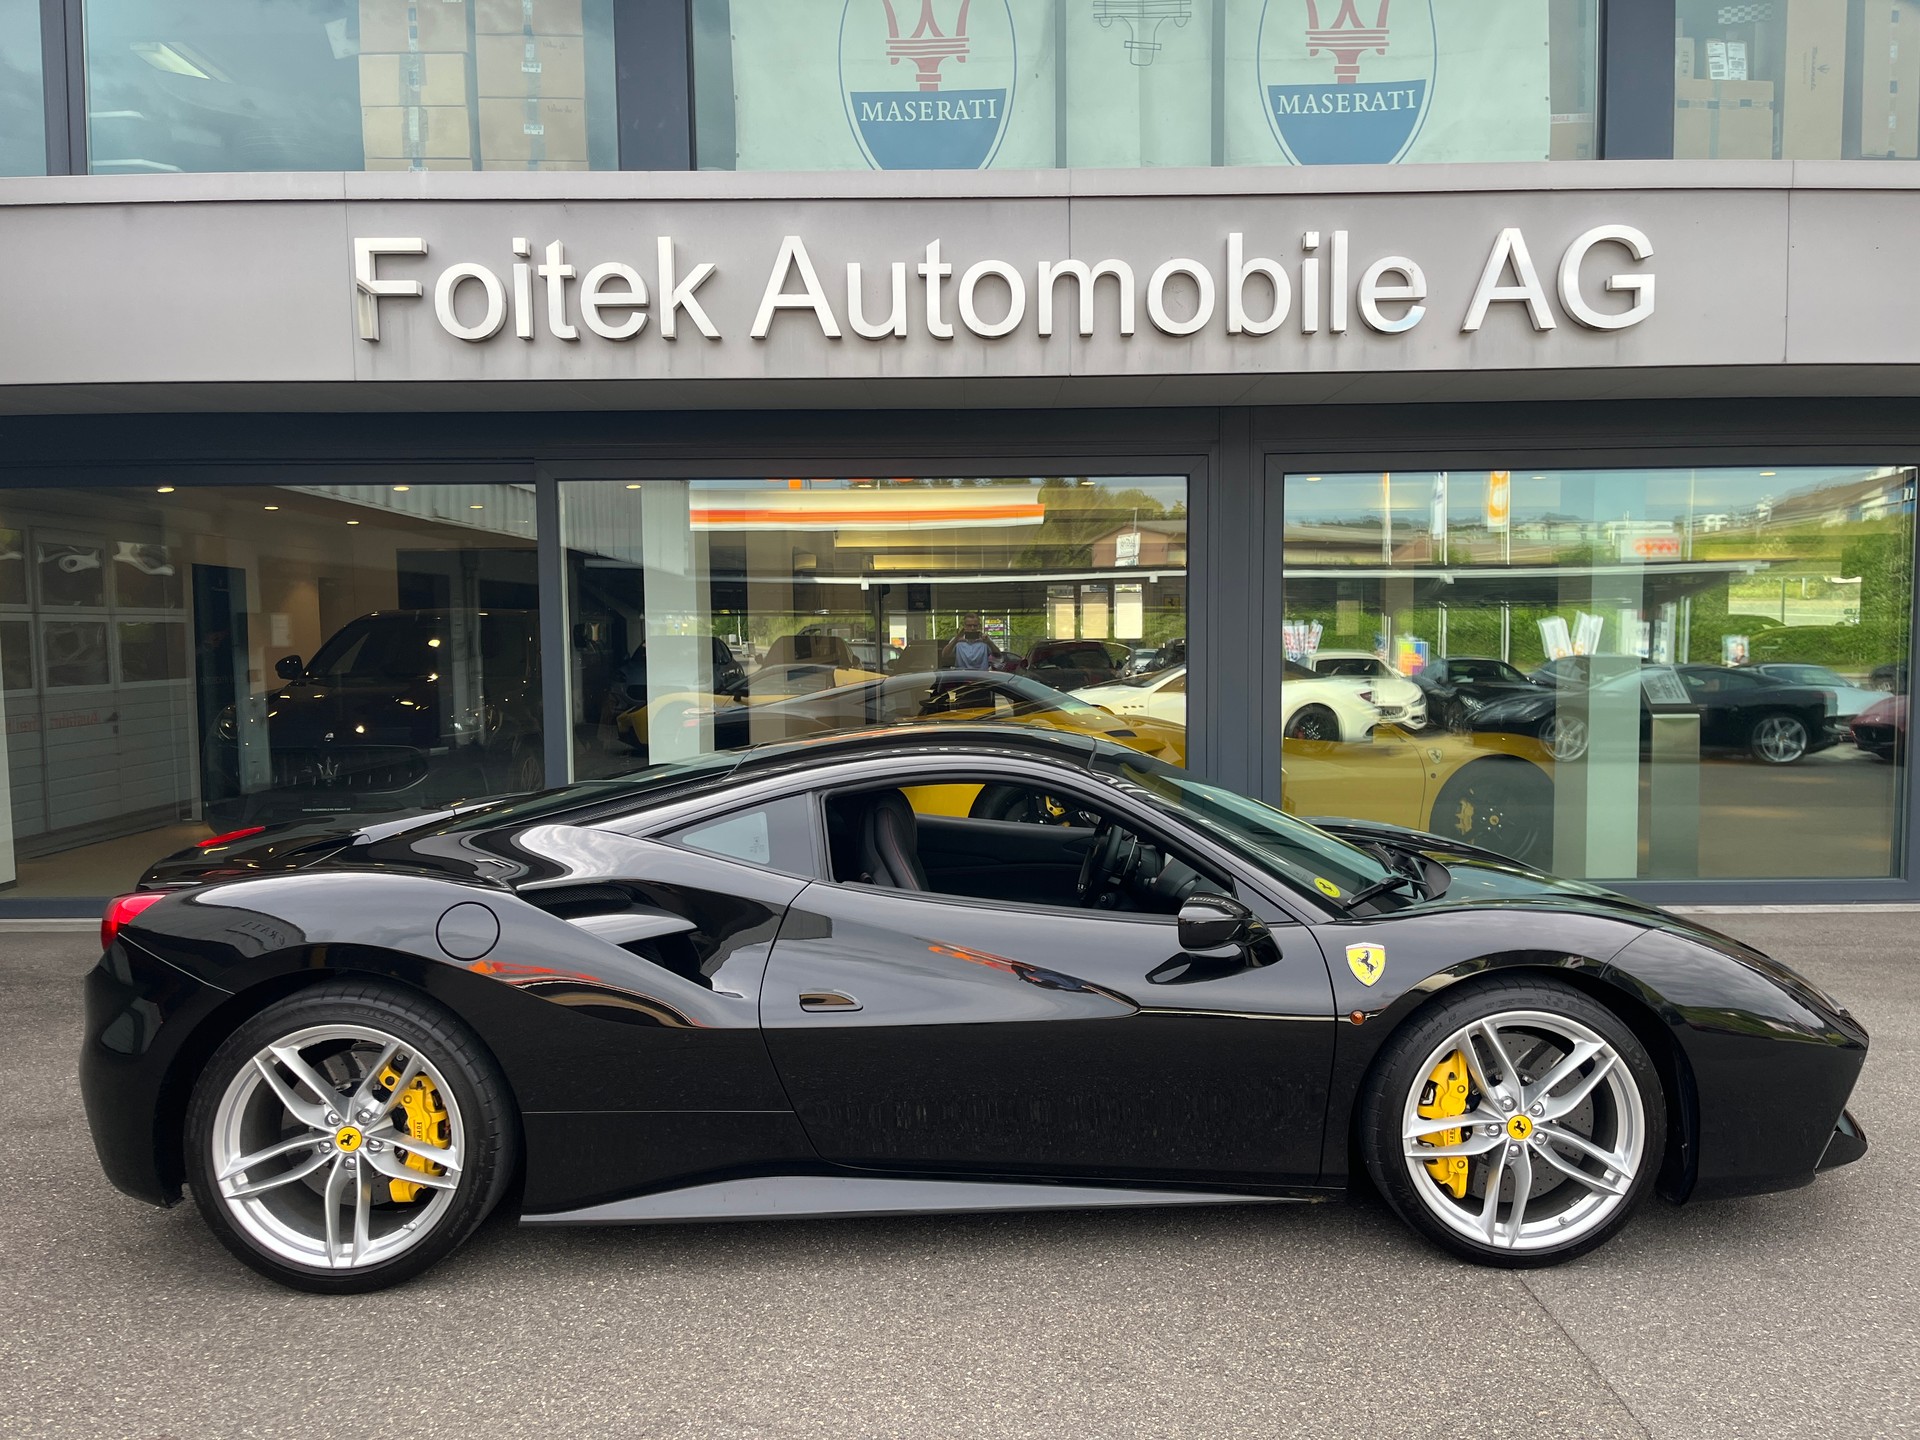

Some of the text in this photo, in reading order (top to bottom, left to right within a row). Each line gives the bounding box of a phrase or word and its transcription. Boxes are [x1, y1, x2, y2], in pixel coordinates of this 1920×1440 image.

[860, 99, 997, 122] MASERATI
[1277, 90, 1416, 115] MASERATI
[354, 224, 1655, 342] Foitek Automobile AG
